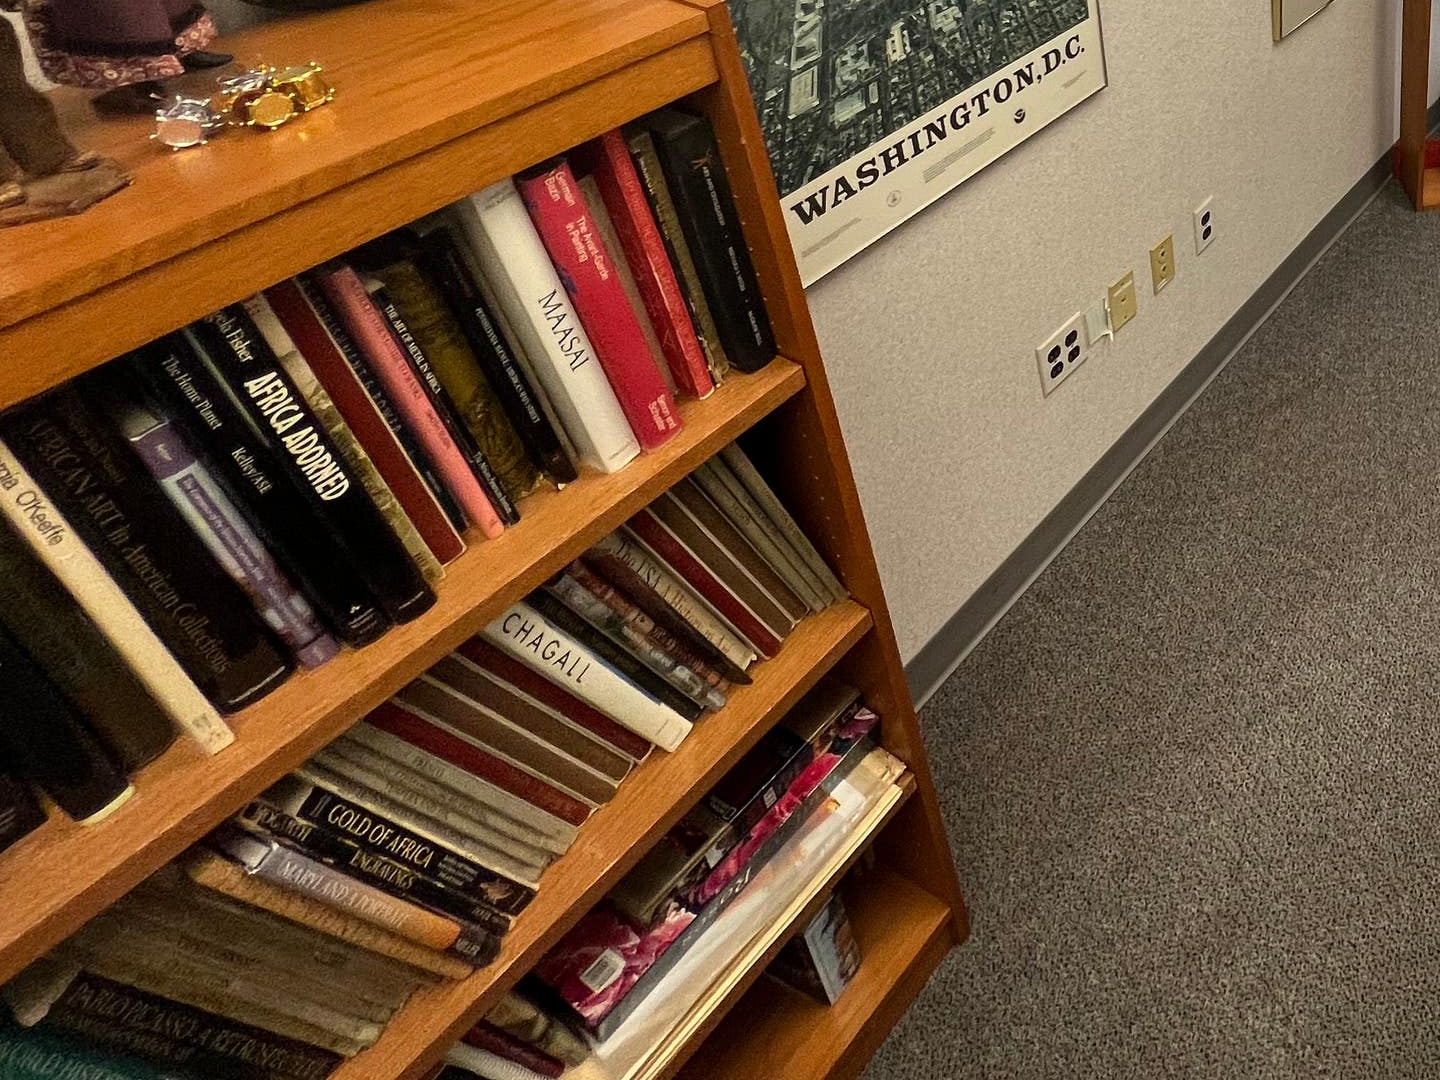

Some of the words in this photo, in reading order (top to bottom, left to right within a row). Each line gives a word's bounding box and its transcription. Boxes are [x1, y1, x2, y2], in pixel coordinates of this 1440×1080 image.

[790, 62, 1042, 226] WASHINGTON,
[1042, 34, 1085, 76] D.C.
[543, 175, 561, 203] Bazin
[569, 229, 589, 263] Painting
[577, 215, 588, 232] The
[583, 231, 609, 281] Avant-Garde
[225, 328, 254, 363] Fisher
[385, 304, 398, 320] THE
[393, 319, 406, 334] ART
[408, 341, 425, 367] METAL
[424, 370, 441, 395] AFRICA
[538, 289, 590, 373] MAASAI
[161, 354, 180, 380] The
[175, 375, 201, 408] Home
[195, 398, 223, 432] Planet
[243, 371, 305, 435] AFRICA
[282, 425, 350, 501] ADORNED
[15, 490, 64, 546] O'Keeffe
[123, 543, 180, 610] American
[171, 601, 229, 673] Collections
[502, 613, 590, 684] CHAGALL
[327, 803, 370, 837] GOLD
[367, 823, 392, 843] OF
[387, 830, 435, 868] AFRICA
[282, 861, 350, 907] MARYLAND
[351, 850, 416, 890] ENGRAVINGS
